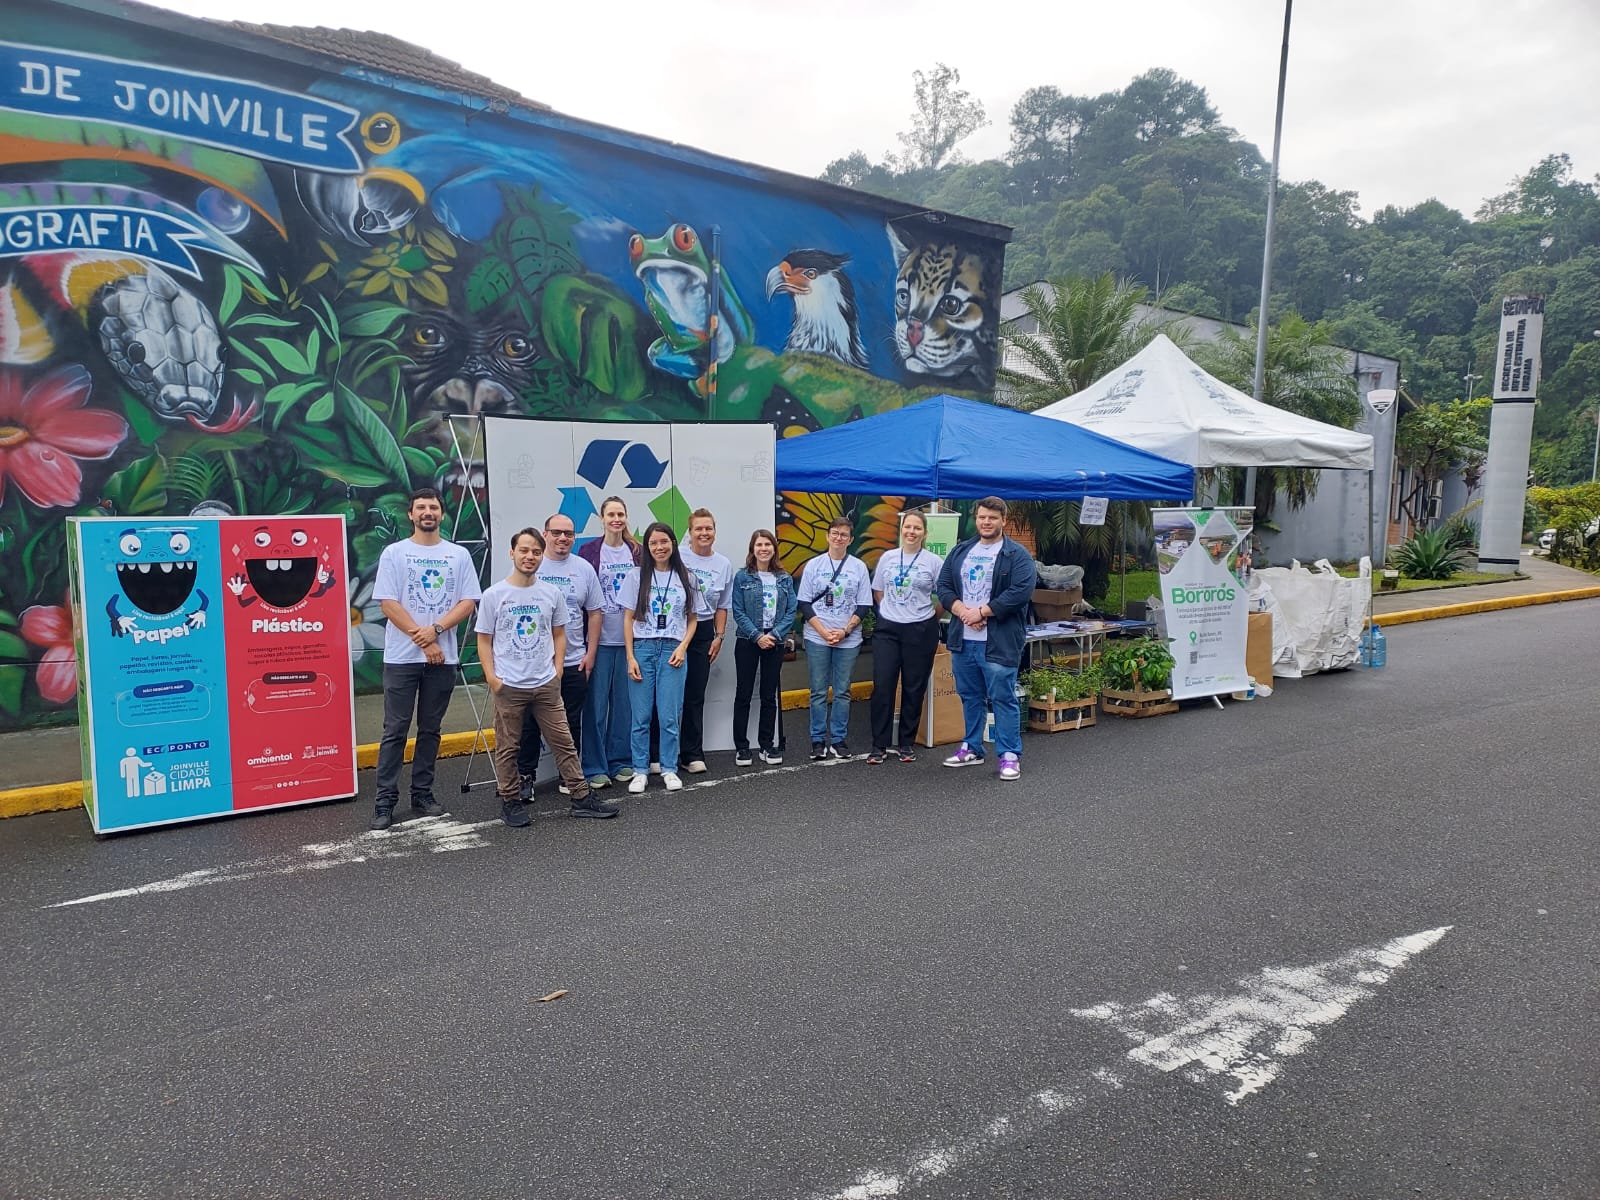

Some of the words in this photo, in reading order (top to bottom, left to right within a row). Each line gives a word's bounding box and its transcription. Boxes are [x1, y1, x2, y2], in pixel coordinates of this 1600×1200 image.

[19, 62, 81, 101] DE
[114, 80, 328, 151] JOINVILLE
[0, 213, 159, 252] GRAFIA
[1171, 582, 1236, 605] Bororós
[251, 617, 324, 633] Plástico
[133, 622, 190, 645] Papel
[170, 761, 209, 771] JOINVILLE
[247, 753, 293, 765] ambiental
[169, 767, 210, 780] CIDADE
[171, 777, 212, 793] LIMPA
